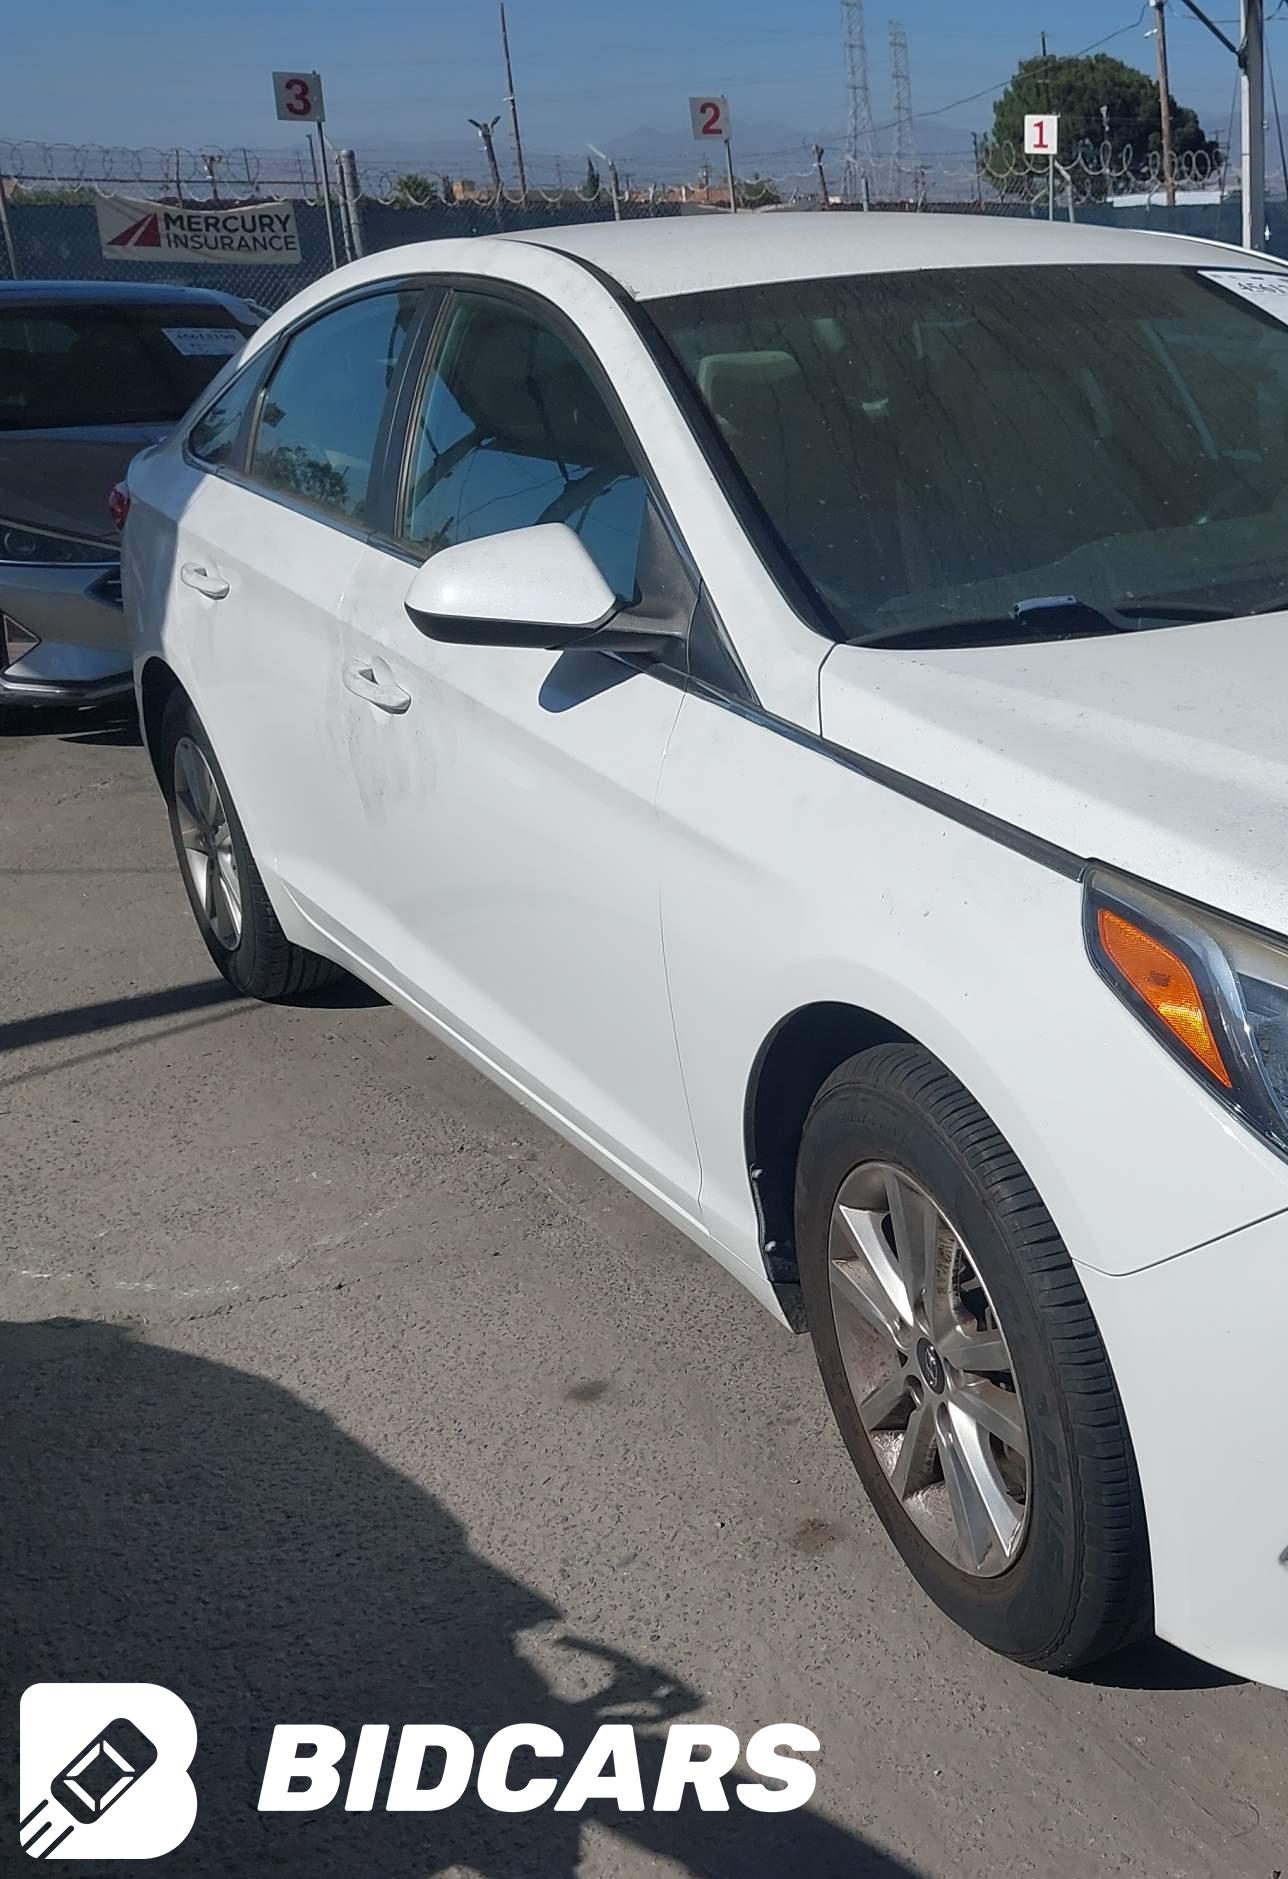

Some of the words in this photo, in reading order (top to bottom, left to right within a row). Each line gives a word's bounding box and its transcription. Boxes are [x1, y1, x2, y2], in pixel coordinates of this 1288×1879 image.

[285, 79, 312, 116] 3
[700, 102, 722, 135] 2
[1033, 120, 1049, 149] 1
[163, 212, 291, 233] MERCURY
[166, 233, 298, 251] INSURANCE
